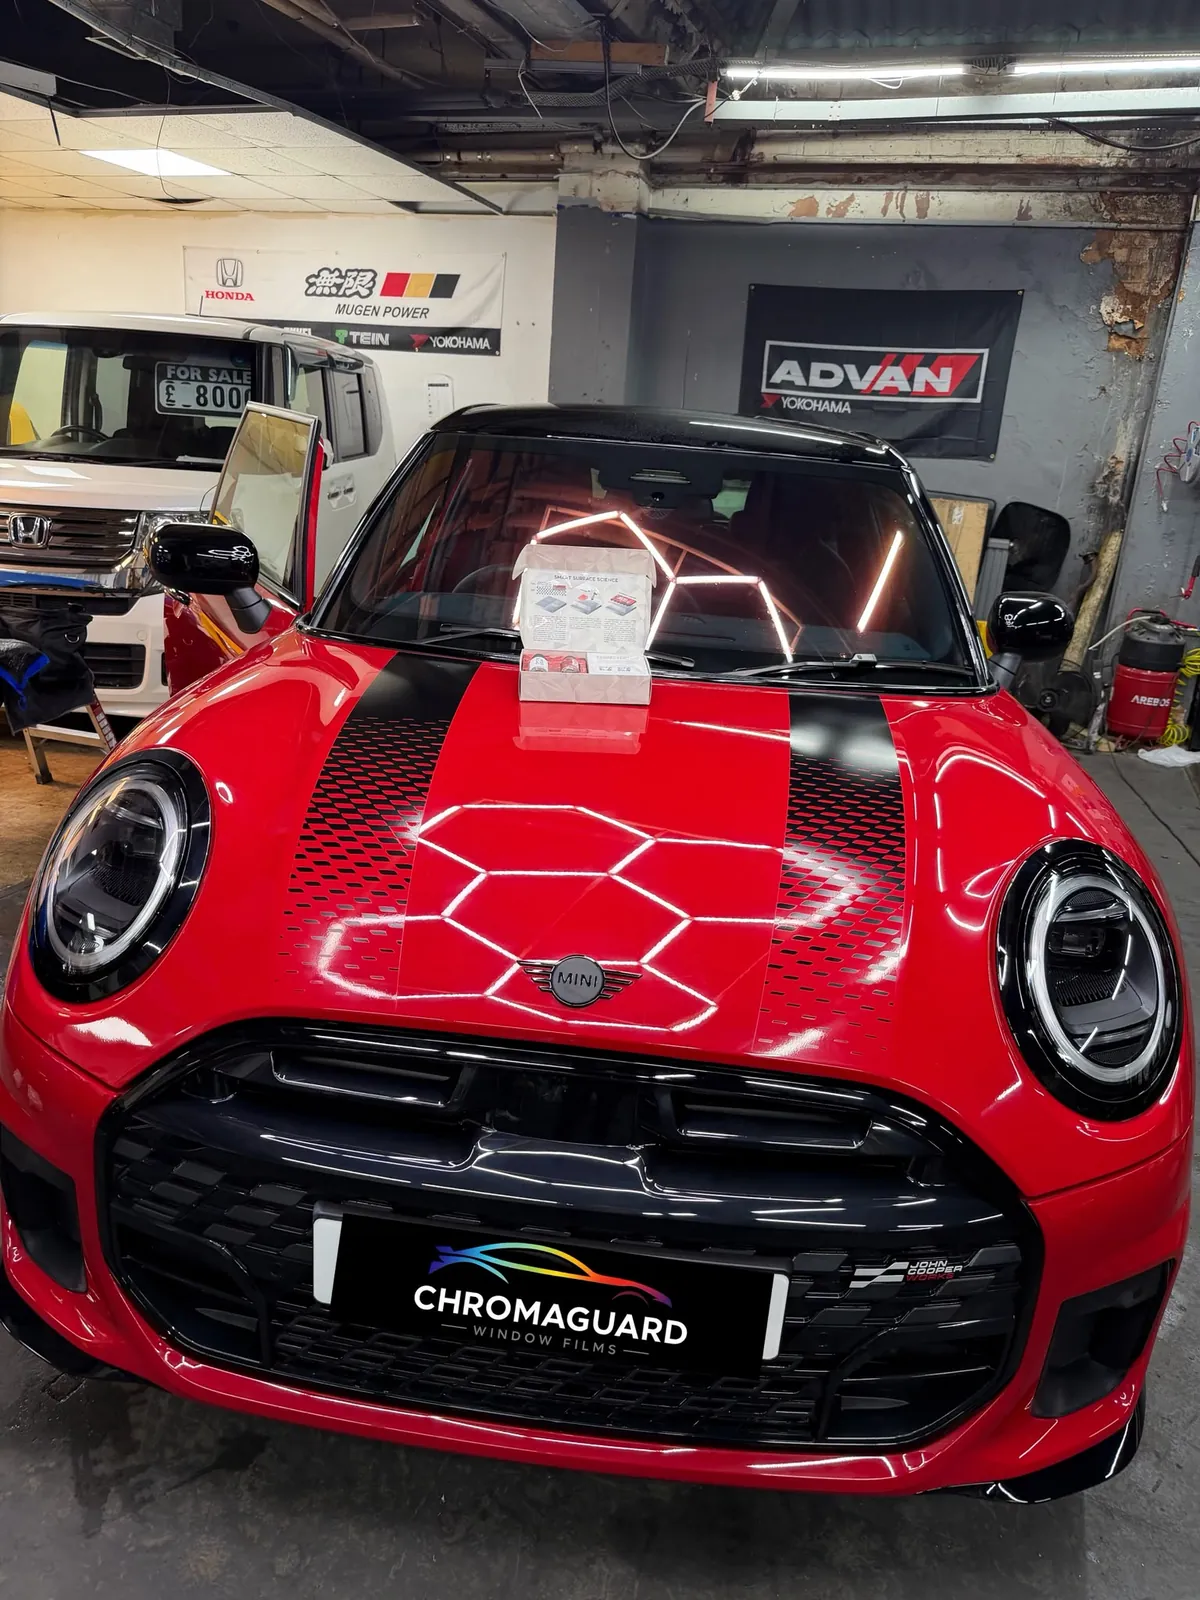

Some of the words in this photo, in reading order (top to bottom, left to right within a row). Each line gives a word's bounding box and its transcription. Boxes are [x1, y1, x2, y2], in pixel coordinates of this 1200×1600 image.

[304, 267, 377, 299] 無限
[205, 290, 255, 302] HONDA
[335, 303, 380, 317] MUGEN
[382, 306, 430, 320] POWER
[349, 331, 390, 346] TEIN
[428, 336, 491, 350] YOKOHAMA
[166, 365, 202, 380] FOR
[208, 368, 251, 384] SALE
[769, 359, 953, 393] ADVAN
[781, 396, 852, 414] YOKOHAMA
[1130, 694, 1172, 707] AREBOS
[557, 971, 598, 988] MINI
[907, 1265, 963, 1275] COOPER
[910, 1260, 948, 1269] JOHN
[906, 1273, 955, 1281] WORKS
